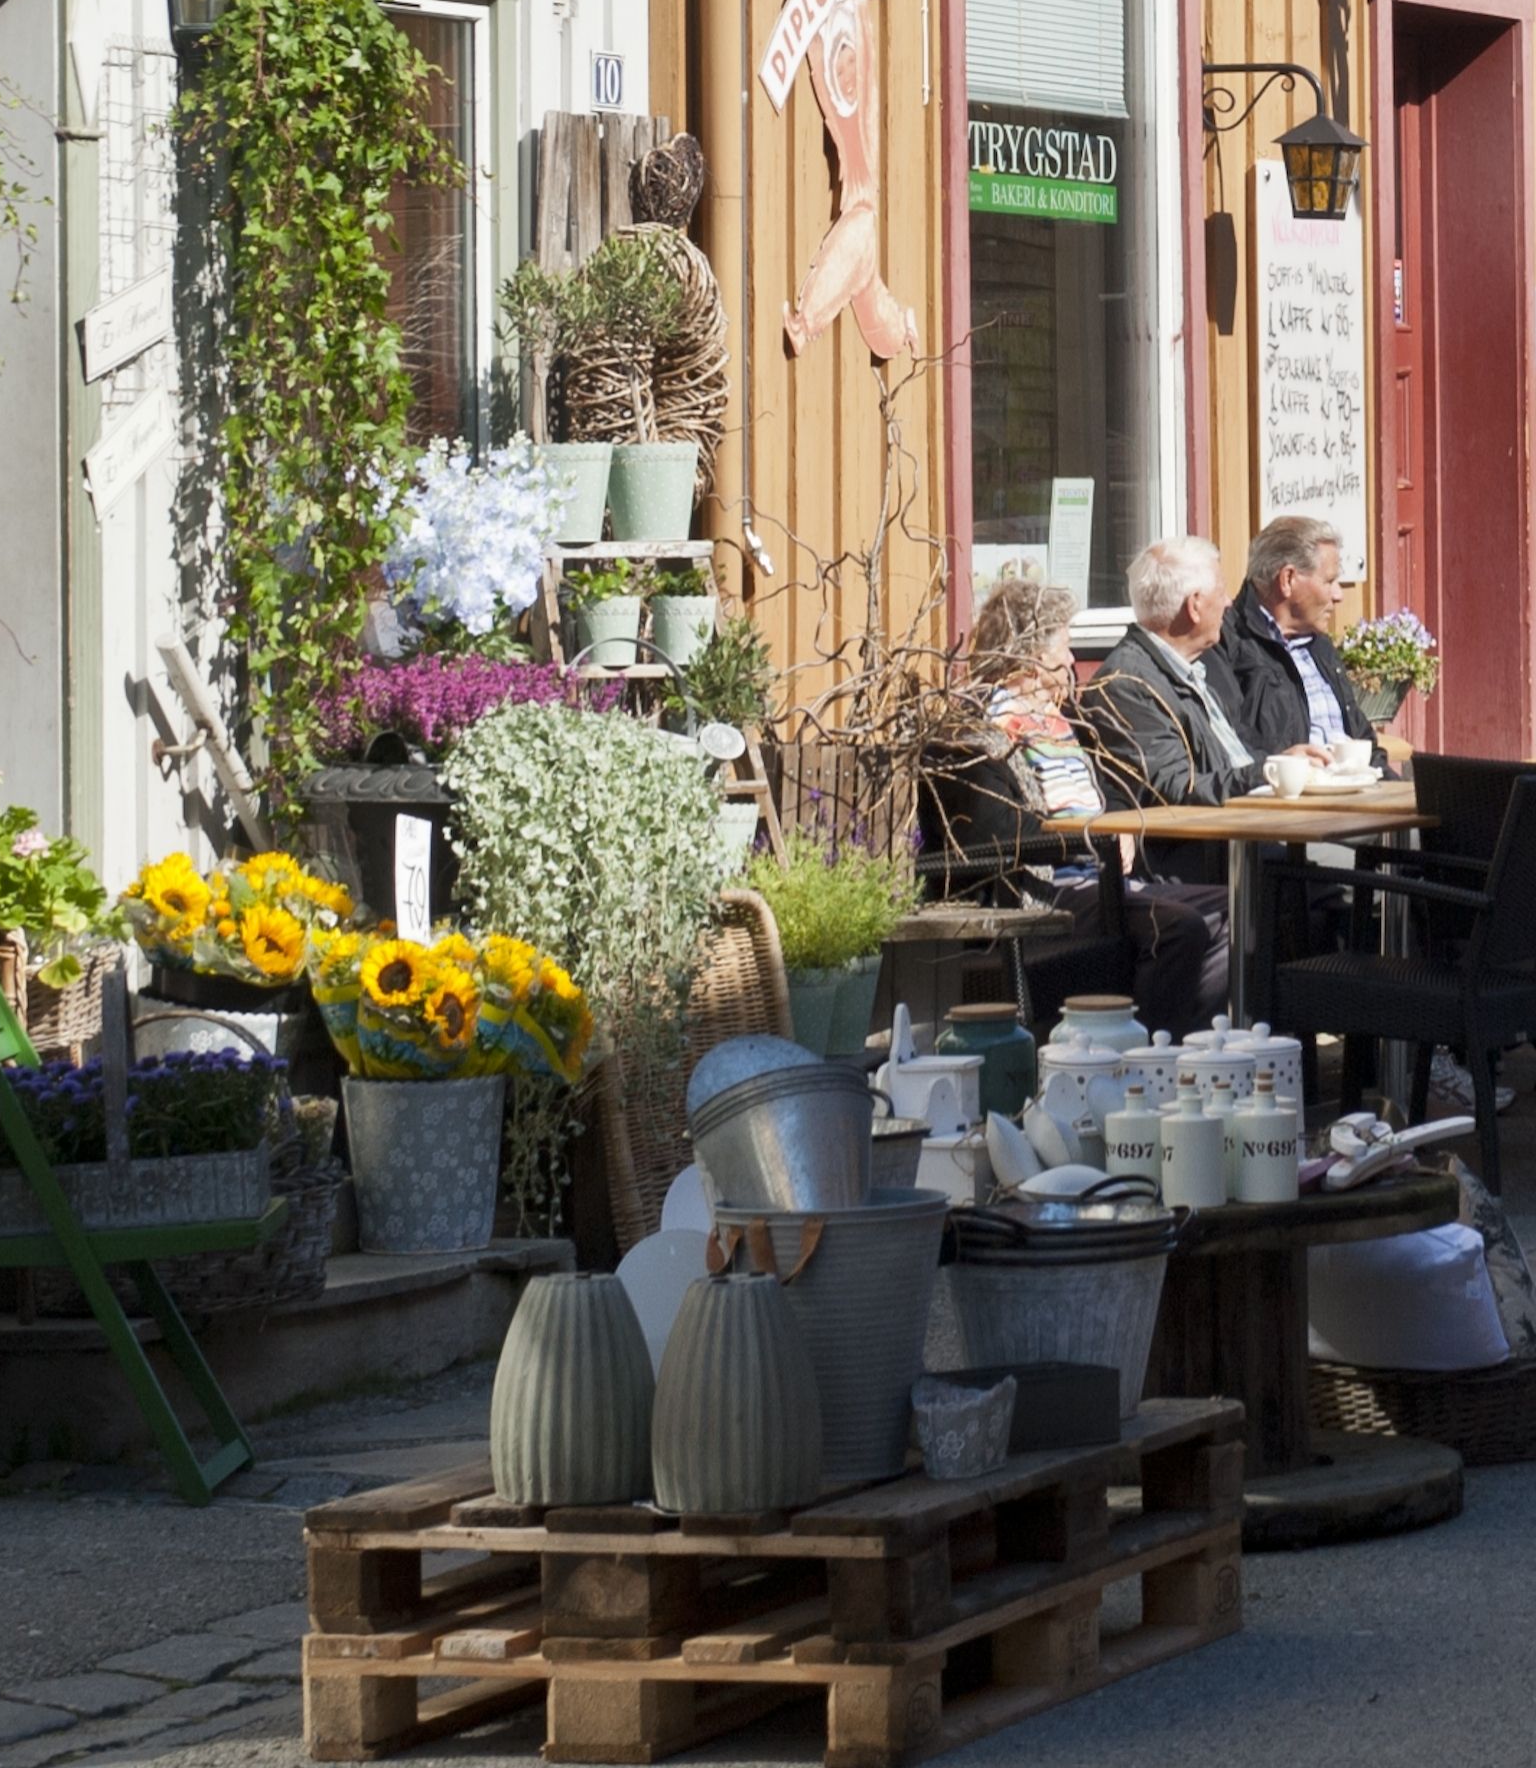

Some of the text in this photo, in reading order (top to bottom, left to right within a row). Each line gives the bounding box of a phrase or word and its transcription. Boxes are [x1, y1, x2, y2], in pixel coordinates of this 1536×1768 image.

[598, 58, 620, 105] 10
[967, 120, 1118, 184] TRYGSTAD
[991, 182, 1036, 209] BAKERI
[1037, 187, 1048, 209] &
[1049, 188, 1114, 217] KONDITORI
[1280, 300, 1313, 333] KAFFE
[1280, 385, 1310, 414] KAFFE
